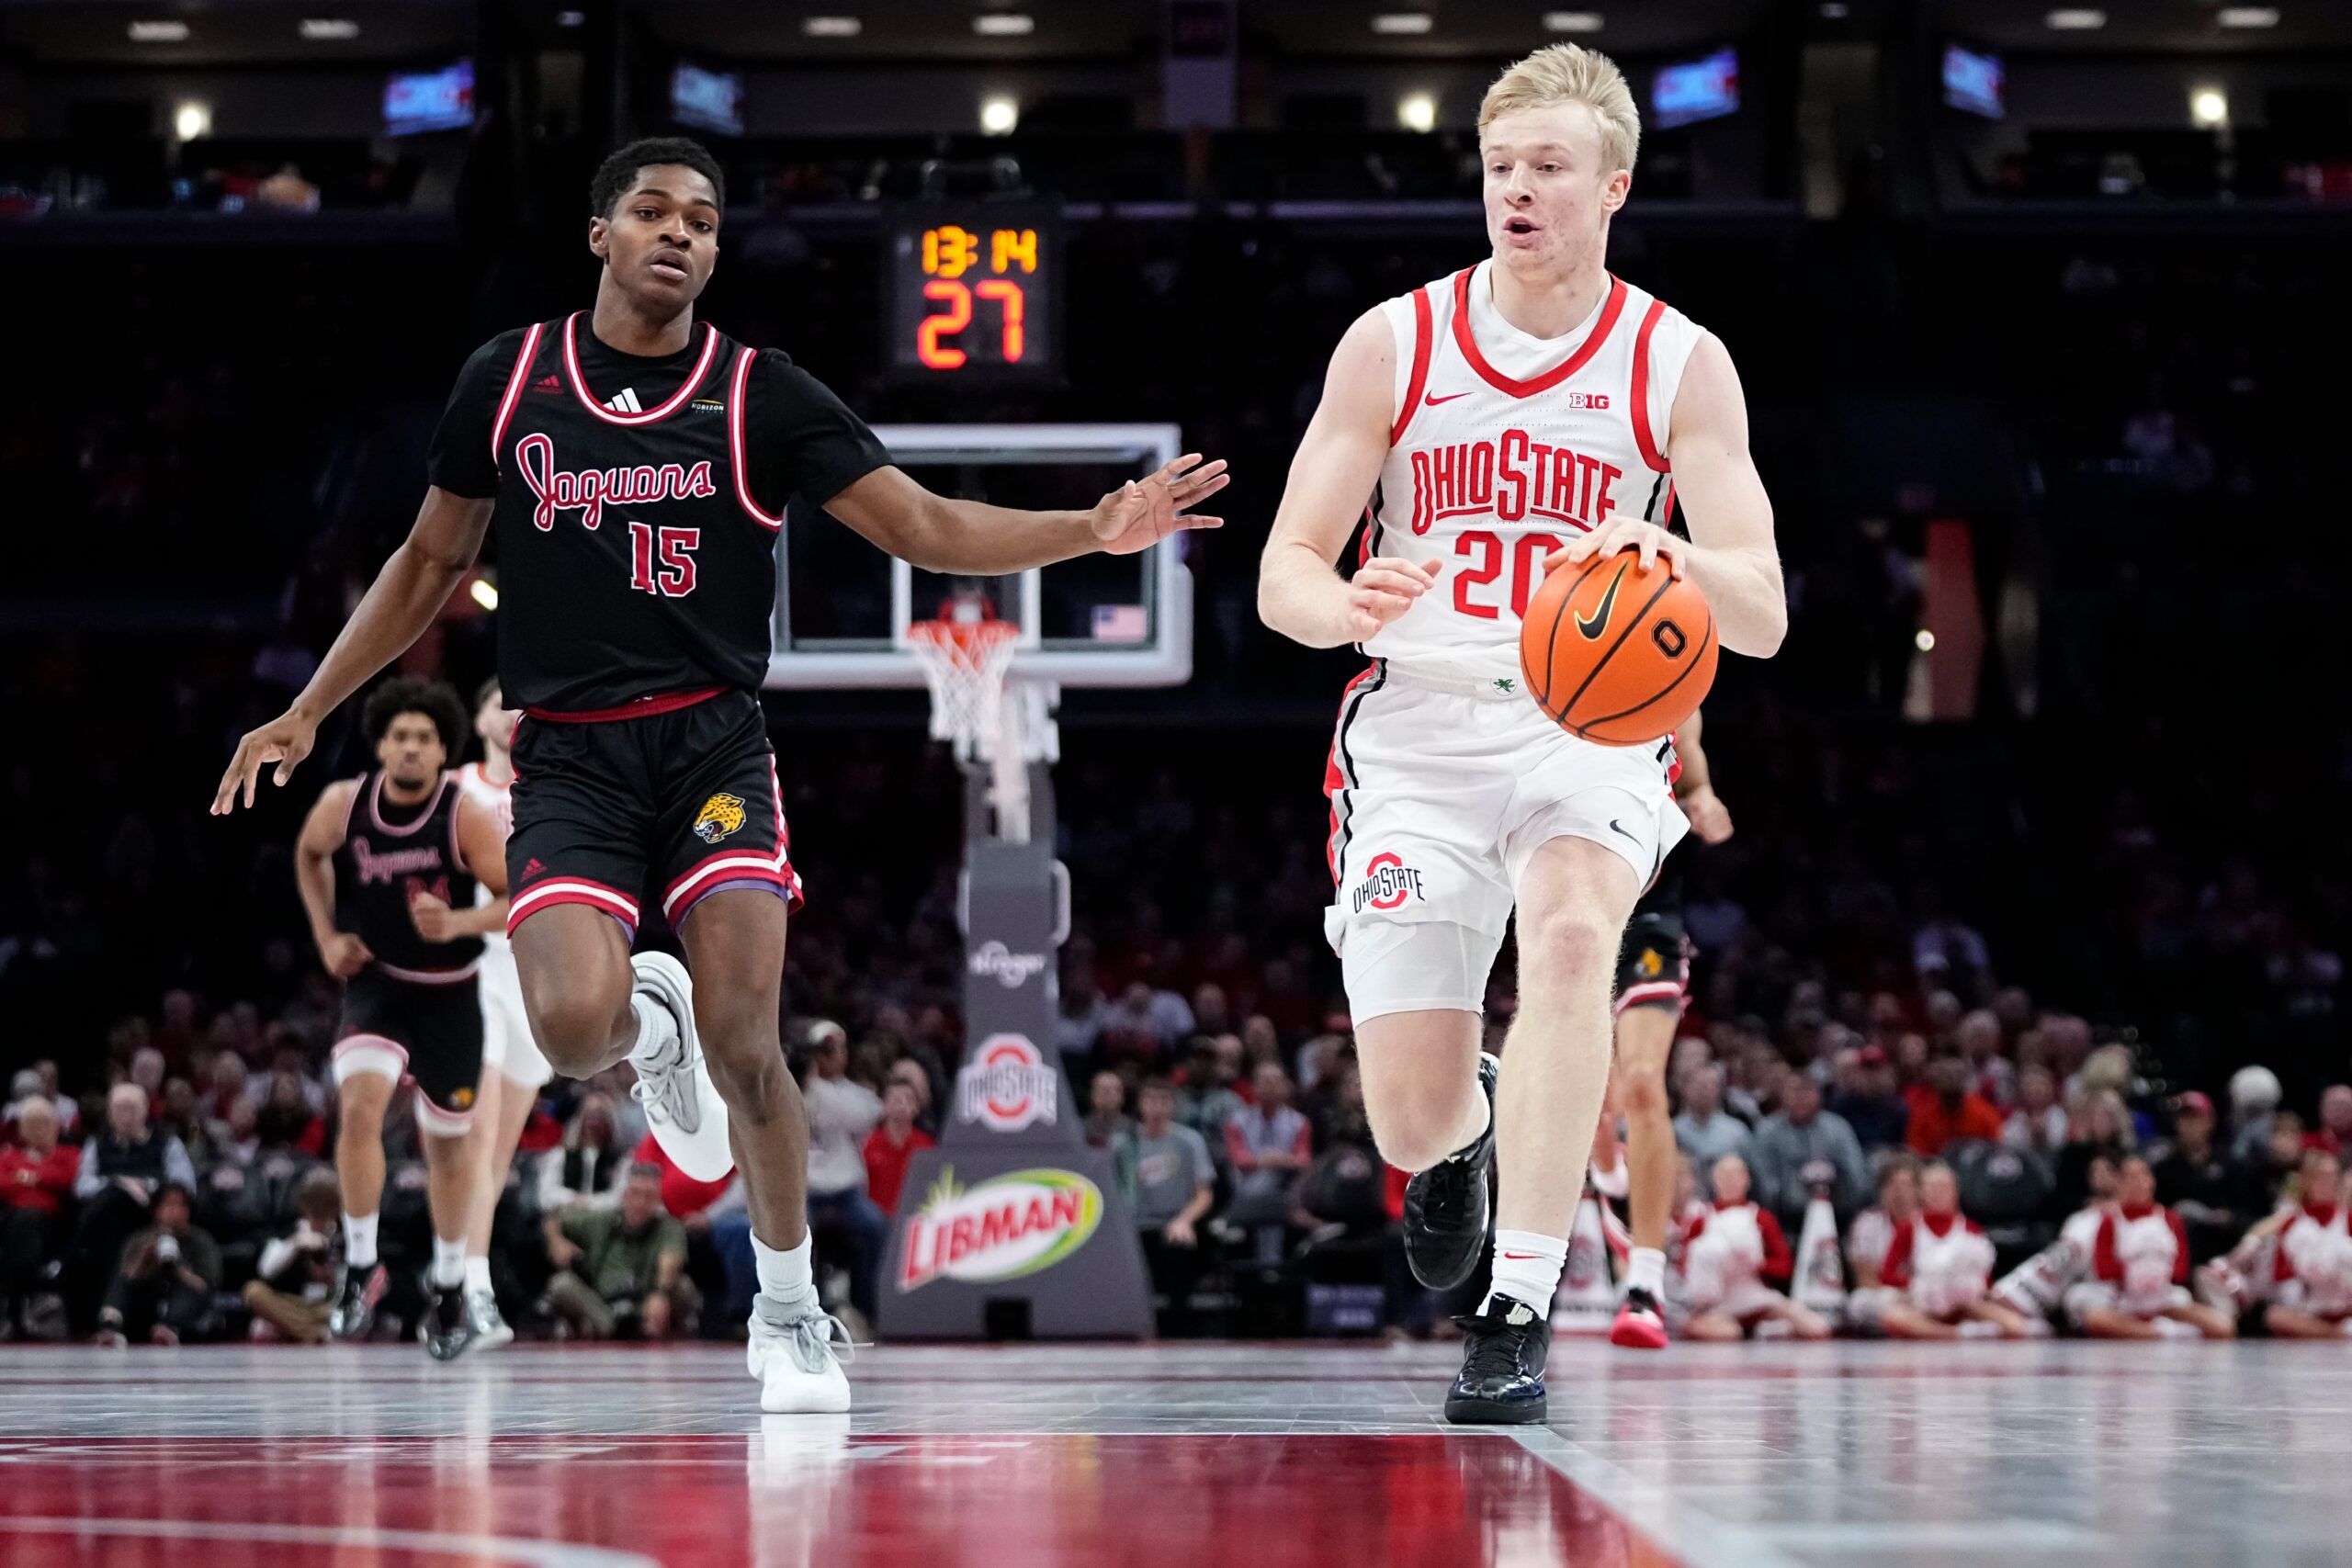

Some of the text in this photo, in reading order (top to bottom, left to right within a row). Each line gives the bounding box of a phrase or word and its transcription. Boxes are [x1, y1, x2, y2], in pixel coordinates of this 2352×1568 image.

[922, 226, 1036, 278] 13:14
[917, 279, 1023, 368] 27
[691, 402, 725, 412] HORIZON
[516, 433, 716, 532] Jaguars
[628, 522, 700, 597] 15
[897, 1186, 1082, 1290] LIBMAN
